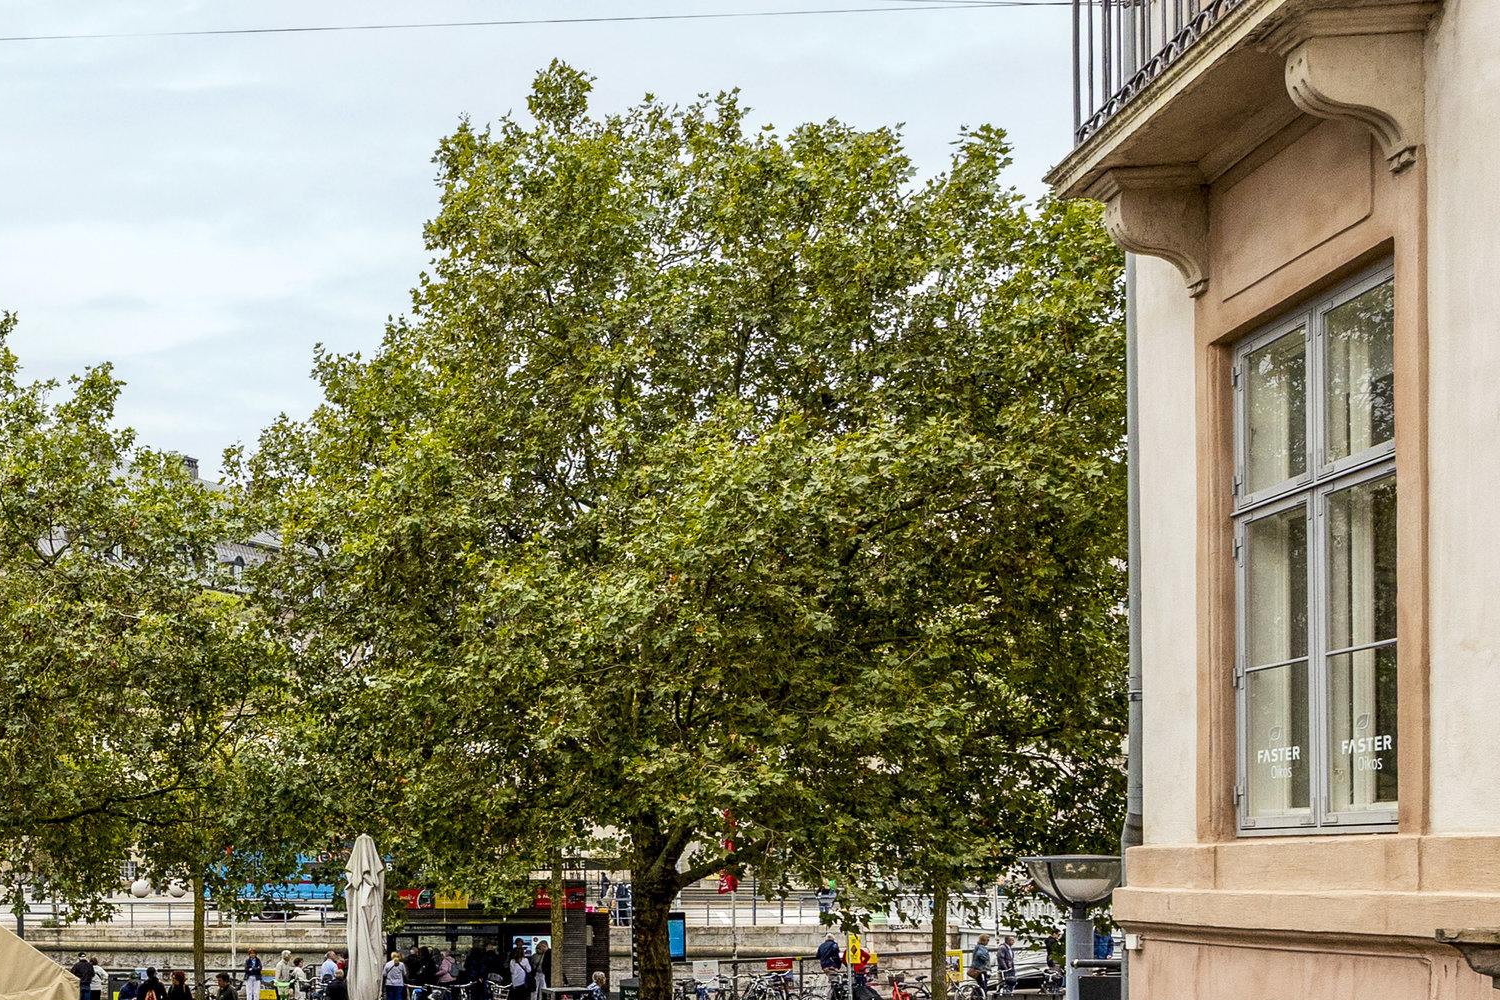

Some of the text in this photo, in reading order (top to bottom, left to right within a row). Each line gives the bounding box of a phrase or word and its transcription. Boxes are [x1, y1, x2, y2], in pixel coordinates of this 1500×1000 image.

[1341, 735, 1392, 755] FASTER
[1257, 746, 1301, 764] FASTER
[1357, 756, 1383, 771] Oikos
